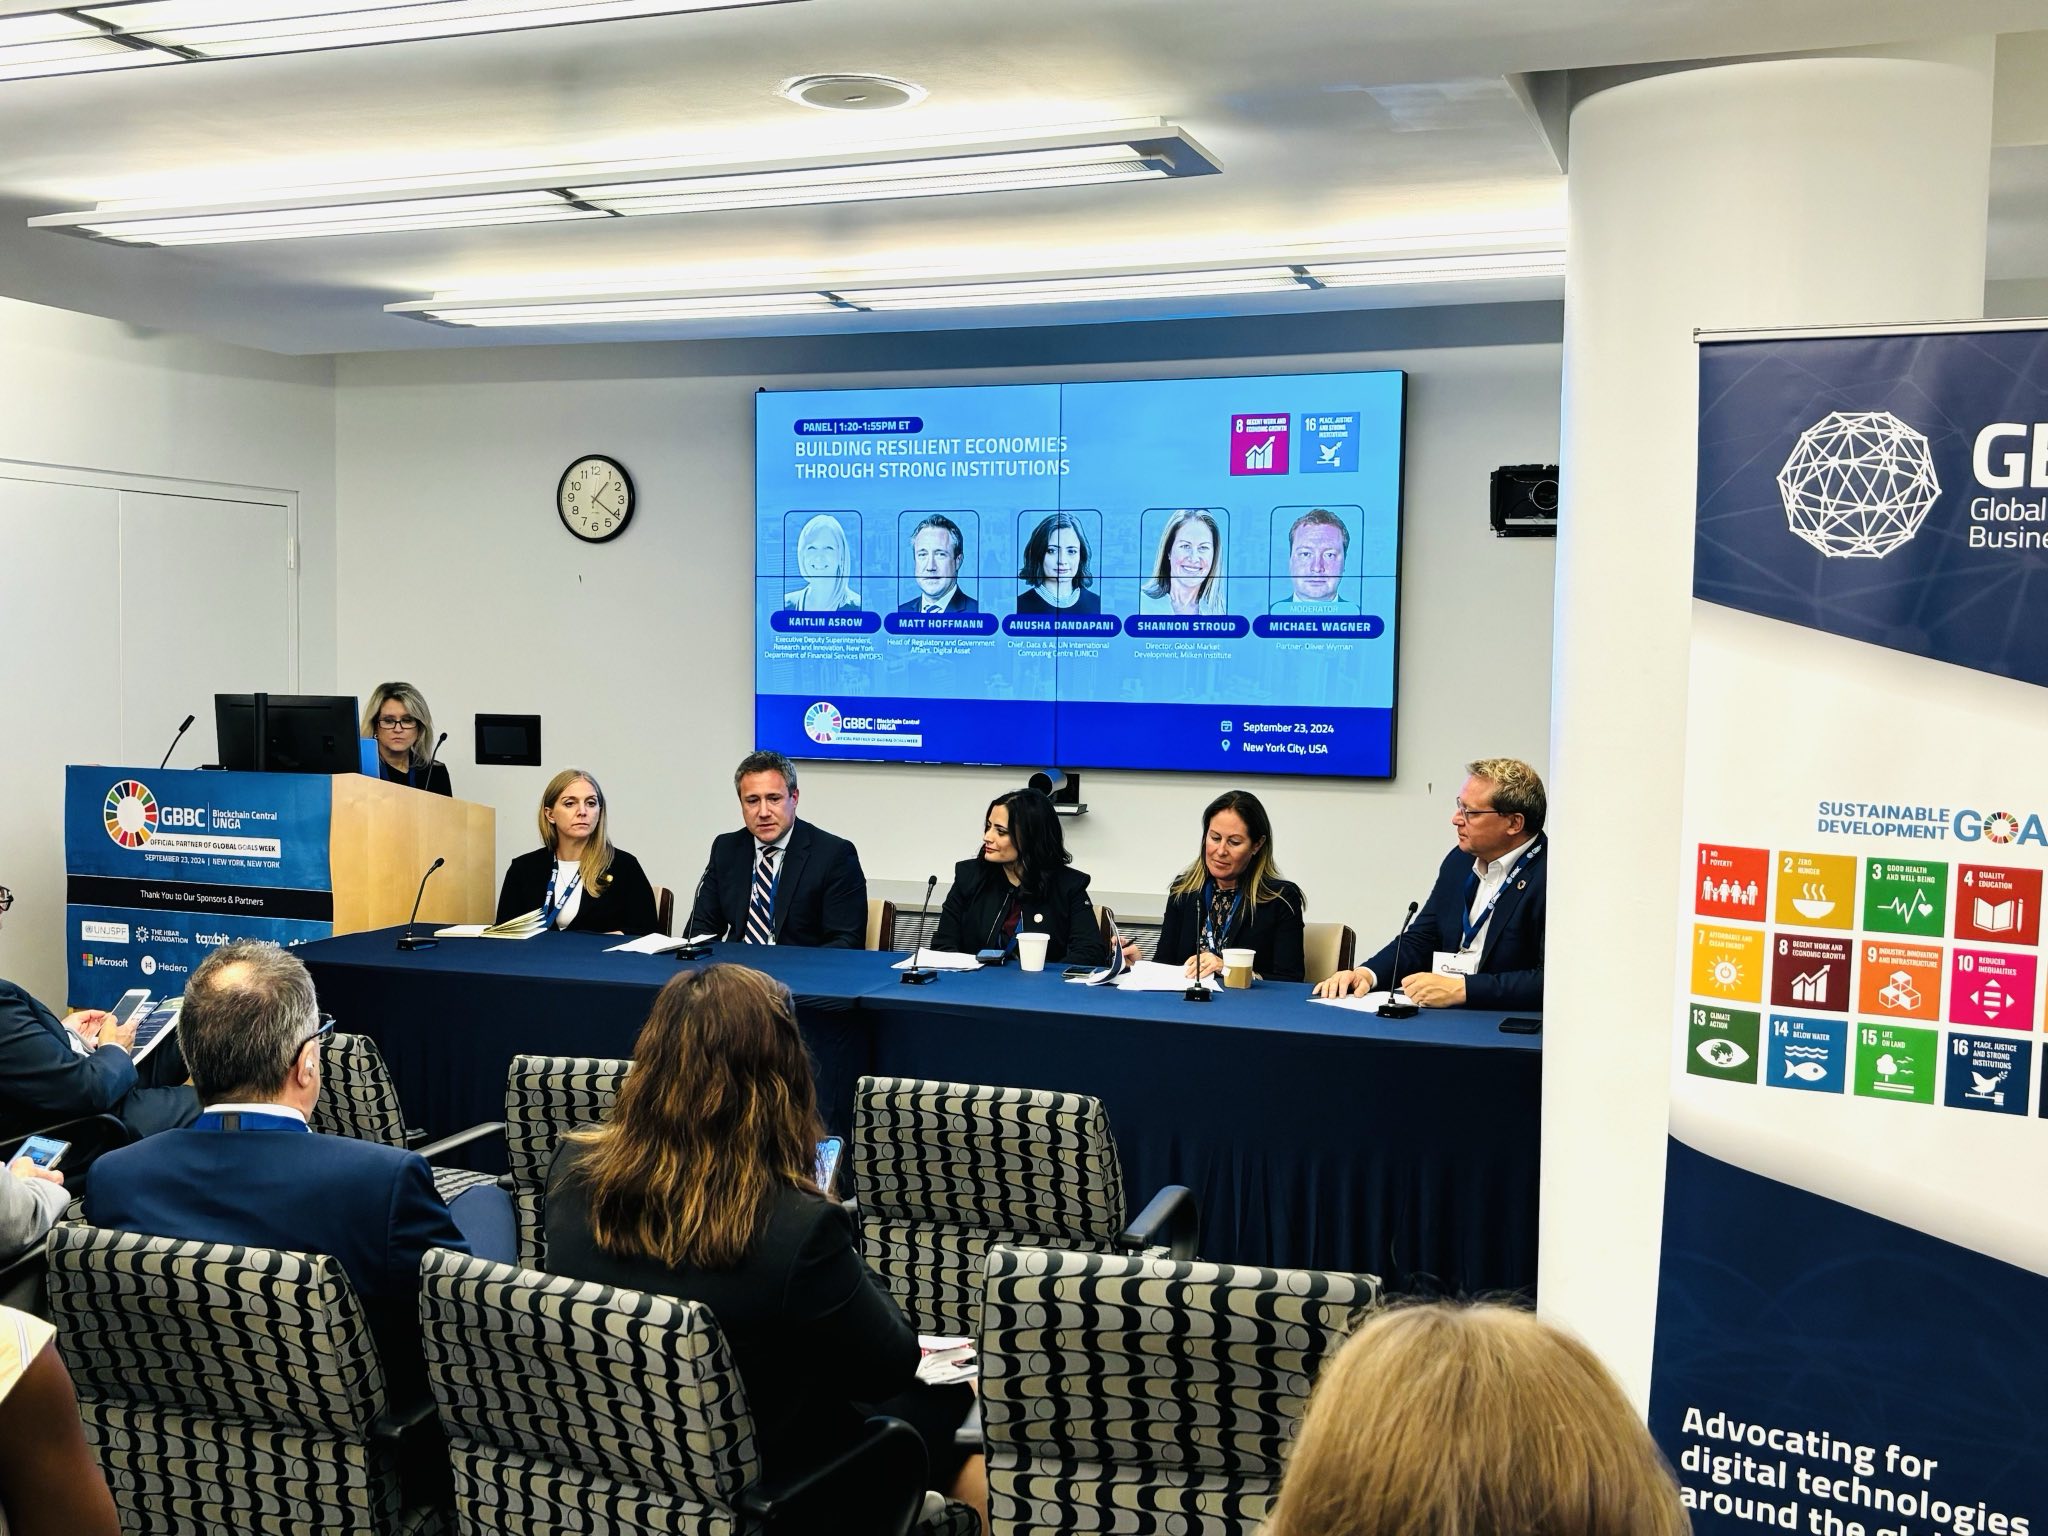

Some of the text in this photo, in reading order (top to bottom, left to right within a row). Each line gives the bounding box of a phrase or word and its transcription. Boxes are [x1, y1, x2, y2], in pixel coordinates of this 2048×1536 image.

[803, 420, 910, 432] PANEL 1:20-1:55PM ET
[1236, 419, 1243, 433] 8
[1305, 418, 1316, 431] 16
[795, 436, 1067, 457] BUILDING RESILIENT ECONOMIES
[591, 466, 600, 476] 12
[795, 460, 1070, 478] THROUGH STRONG INSTITUTIONS
[581, 470, 588, 479] 11
[571, 482, 582, 491] 10
[614, 482, 622, 491] 2
[568, 492, 574, 502] 9
[618, 495, 624, 504] 3
[572, 506, 579, 515] 8
[614, 508, 620, 516] 4
[1970, 497, 2046, 522] Global
[582, 516, 588, 526] 7
[604, 518, 612, 528] 5
[592, 522, 598, 532] 6
[1290, 606, 1338, 614] MODERATOR
[789, 618, 862, 626] KAITLIN ASROW
[899, 619, 984, 628] MATT HOFFMANN
[1010, 621, 1114, 630] ANUSHA DANDAPANI
[1138, 622, 1236, 631] SHANNON STROUD
[1270, 622, 1371, 632] MICHAEL WAGNER
[843, 718, 873, 730] GBBC
[1243, 722, 1334, 734] September 23, 2024
[1244, 742, 1328, 755] New York City, USA
[161, 806, 206, 827] GBBC
[212, 810, 278, 820] Blockchain Central
[1819, 802, 1950, 822] SUSTAINABLE
[213, 818, 240, 829] UNGA
[1818, 819, 1949, 840] DEVELOPMENT
[150, 838, 174, 846] OFFICIAL
[176, 840, 202, 848] PARTNER
[144, 854, 180, 862] SEPTEMBER
[181, 856, 190, 864] 23,
[190, 856, 206, 864] 2024
[212, 858, 227, 866] NEW
[228, 858, 246, 867] YORK,
[247, 860, 262, 868] NEW
[1702, 850, 1706, 864] 1
[1798, 858, 1812, 866] ZERO
[1784, 857, 1793, 873] 2
[1887, 864, 1927, 874] GOOD HEALTH
[1872, 864, 1882, 880] 3
[1979, 872, 2005, 880] QUALITY
[1886, 874, 1899, 882] AND
[1964, 870, 1974, 886] 4
[1978, 880, 2012, 890] EDUCATION
[140, 890, 264, 906] Thank You to Our Sponsors & Partners
[93, 926, 127, 936] UNJSPF
[151, 928, 162, 936] THE
[151, 935, 188, 944] FOUNDATION
[1698, 930, 1704, 944] 7
[1779, 940, 1788, 955] 8
[1792, 940, 1812, 949] DECENT
[1814, 942, 1830, 950] WORK
[1822, 952, 1846, 960] GROWTH
[1868, 946, 1876, 962] 9
[94, 956, 128, 968] Microsoft
[158, 962, 188, 972] Hedera
[1958, 954, 1974, 972] 10
[1978, 966, 2017, 976] INEQUALITIES
[1693, 1010, 1706, 1026] 13
[1710, 1021, 1728, 1030] ACTION
[1774, 1021, 1788, 1037] 14
[1794, 1022, 1804, 1030] LIFE
[1793, 1031, 1830, 1040] BELOW WATER
[1862, 1029, 1878, 1045] 15
[1882, 1039, 1906, 1048] ON LAND
[1953, 1038, 1968, 1056] 16
[1994, 1043, 2017, 1052] JUSTICE
[1973, 1050, 2010, 1060] AND STRONG
[1972, 1060, 2012, 1070] INSTITUTIONS
[1682, 1407, 1938, 1481] Advocating for
[1681, 1444, 2030, 1536] digital technologies
[1678, 1486, 1866, 1536] around the
